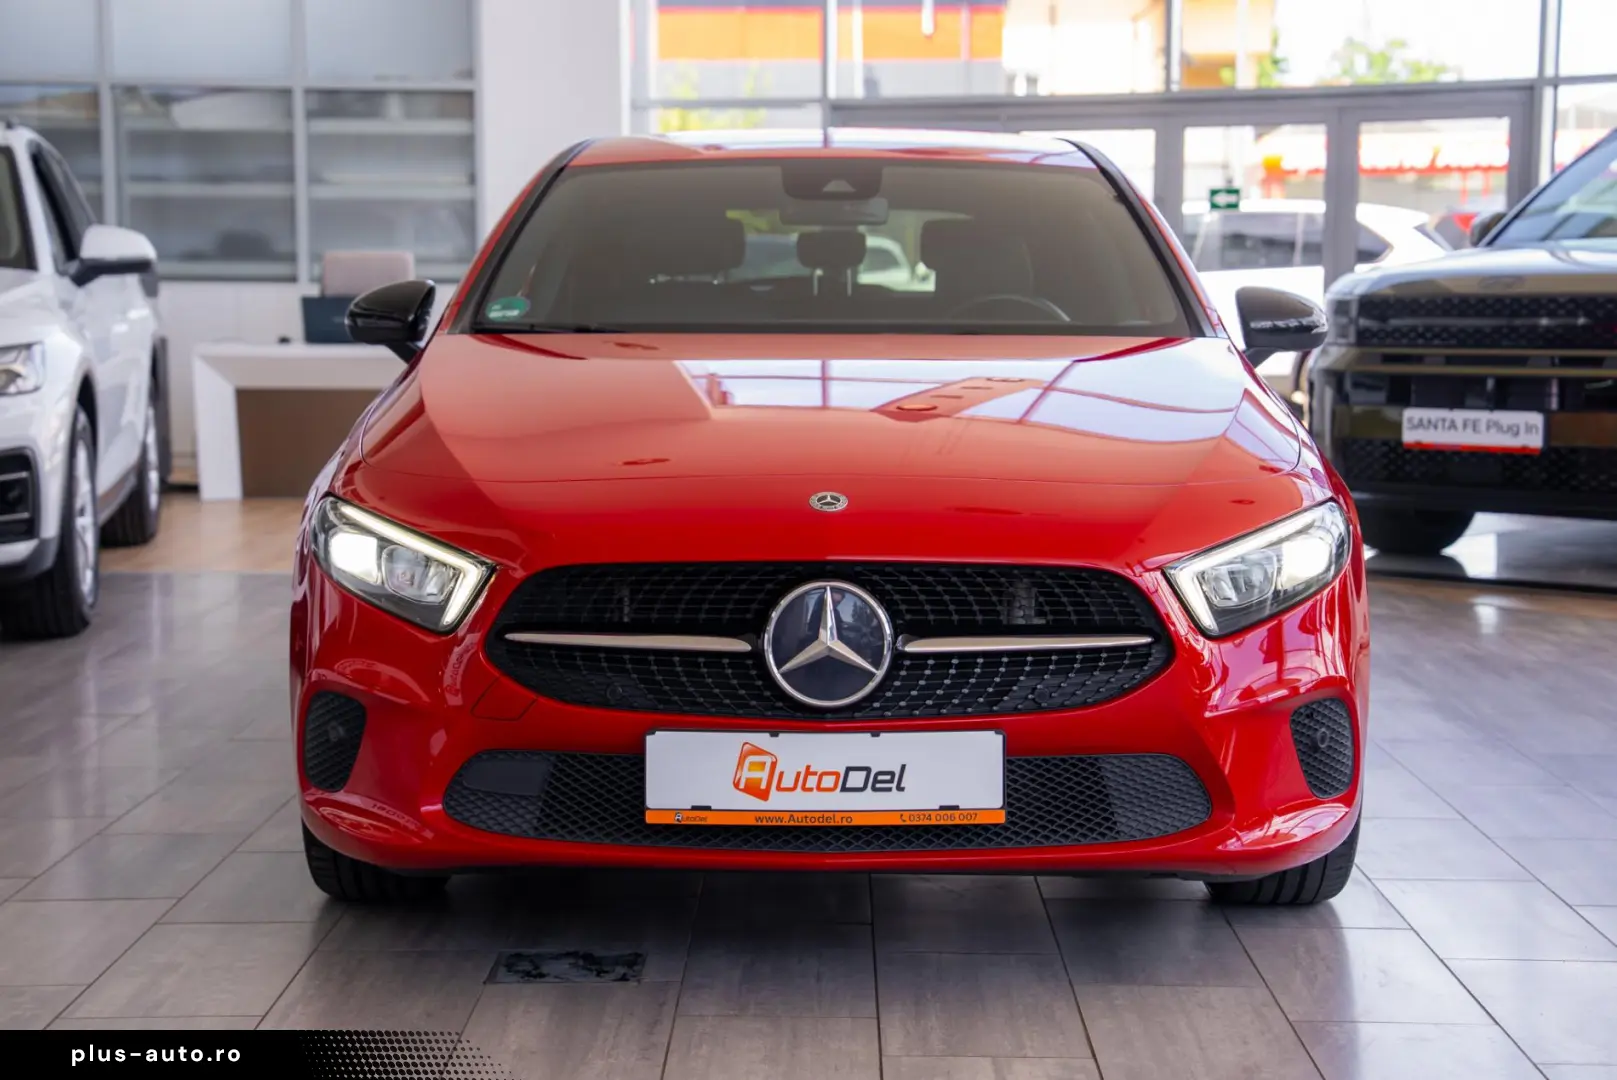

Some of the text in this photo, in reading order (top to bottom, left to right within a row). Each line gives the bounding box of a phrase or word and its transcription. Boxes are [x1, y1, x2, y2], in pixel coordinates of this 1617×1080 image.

[1406, 416, 1540, 436] SANTA FE Plug In
[736, 751, 907, 795] AutoDel
[754, 813, 854, 824] www.Autodel.ro
[908, 812, 978, 823] 0374 006 007
